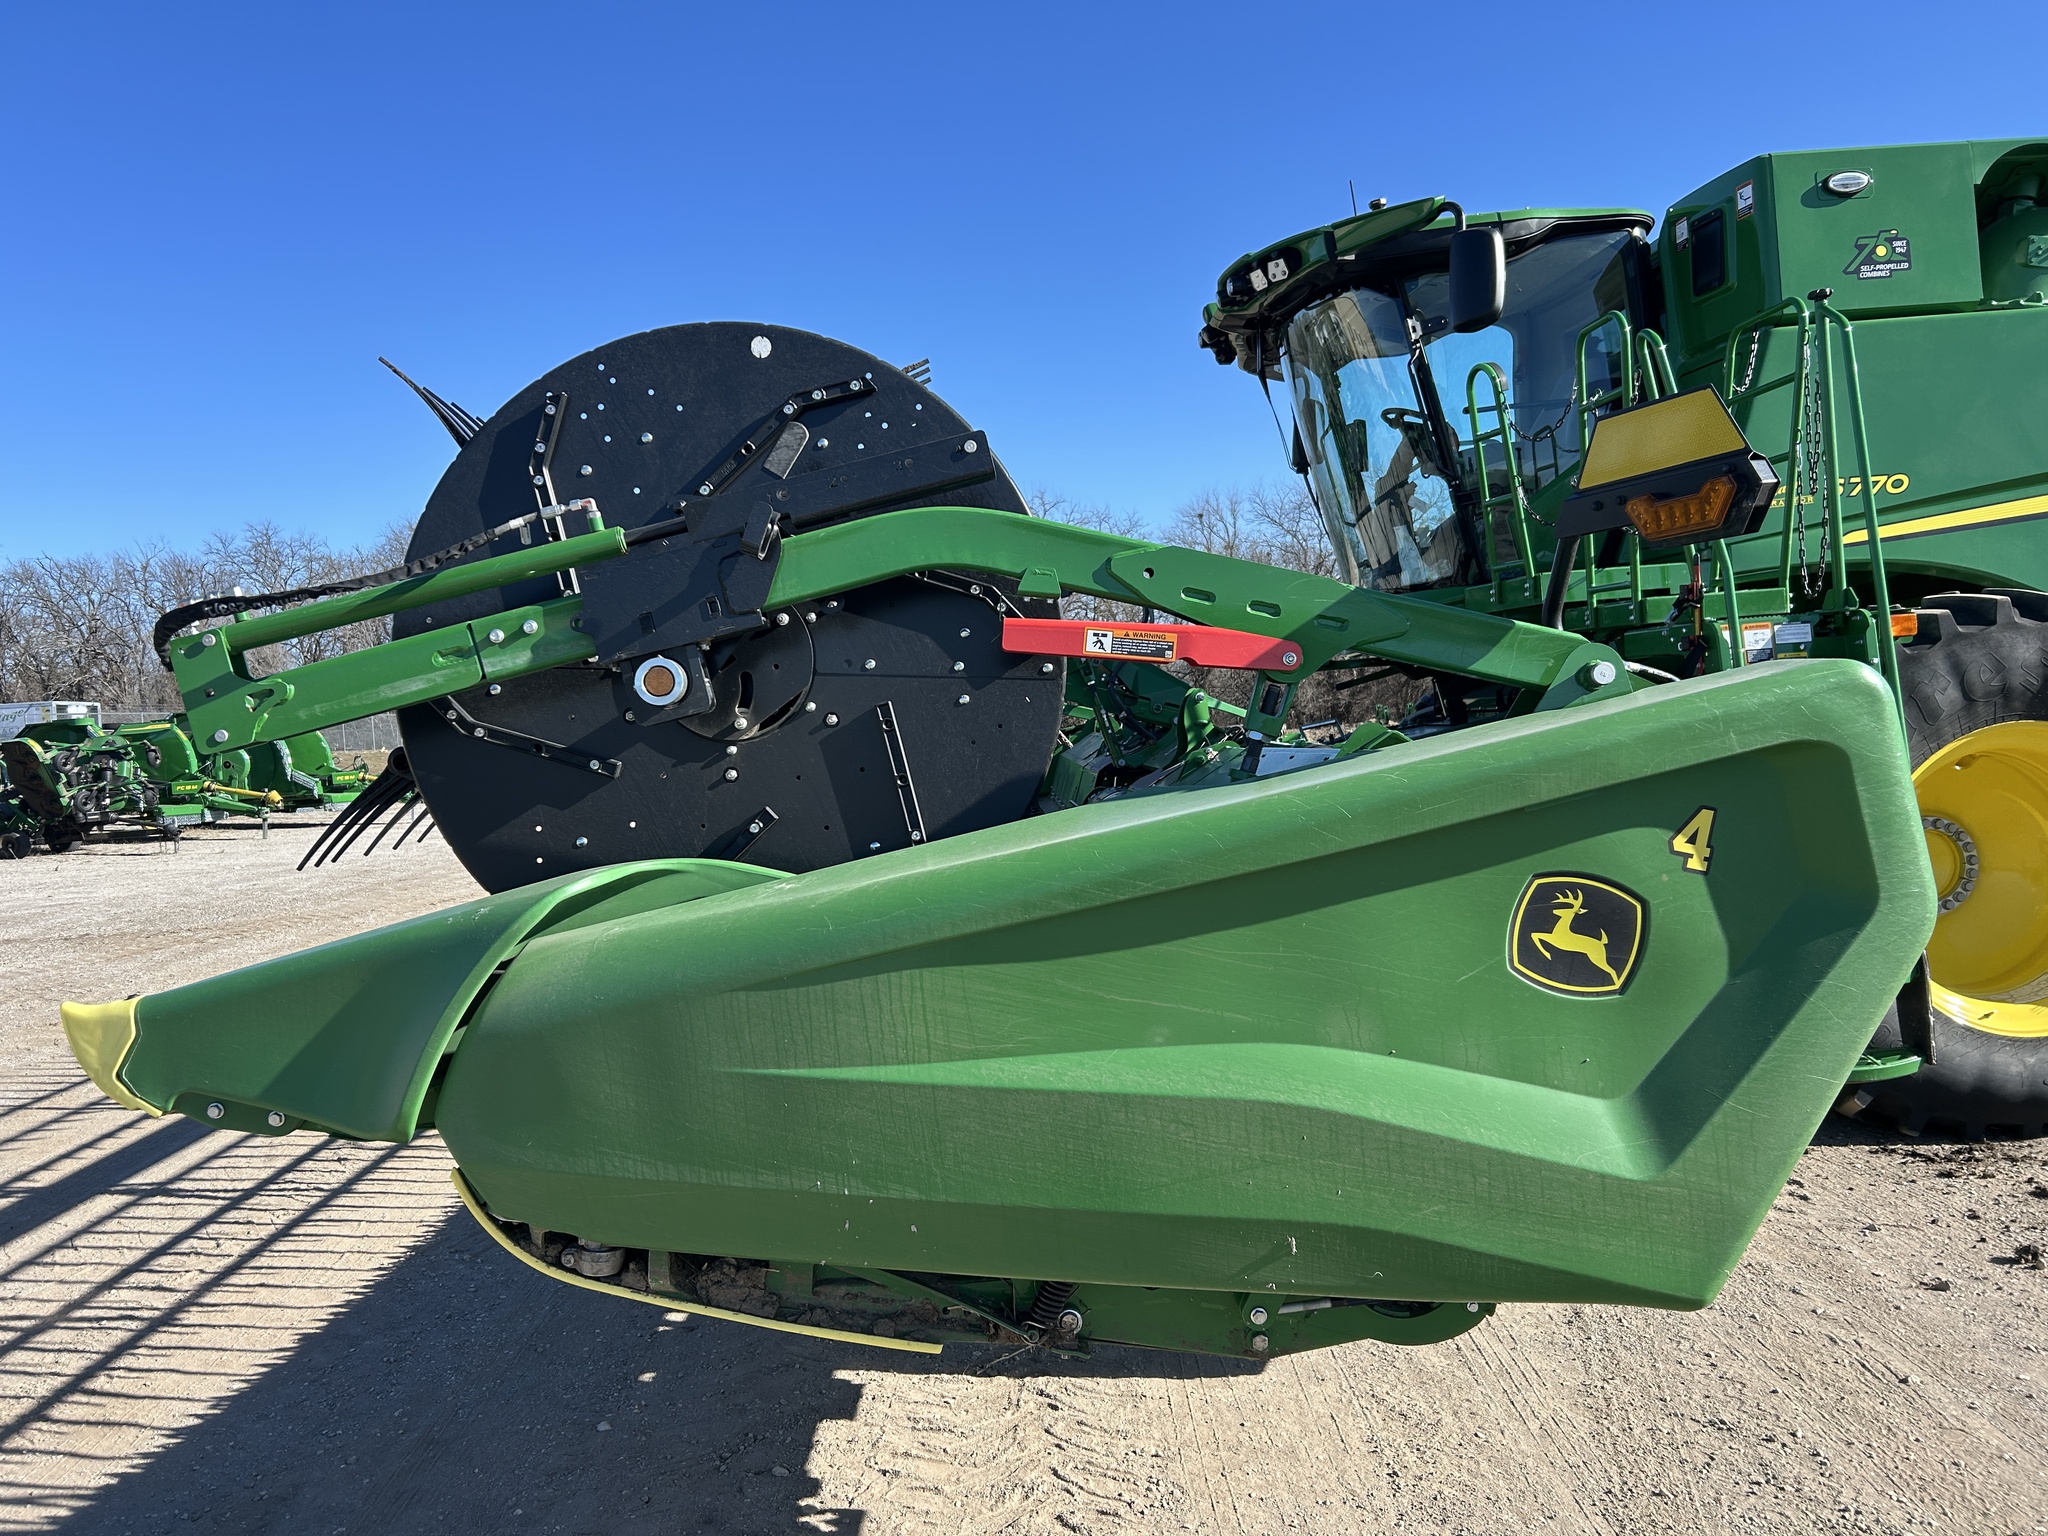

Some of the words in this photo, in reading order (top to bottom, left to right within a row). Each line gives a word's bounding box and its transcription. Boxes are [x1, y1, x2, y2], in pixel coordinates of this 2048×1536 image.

[1860, 262, 1909, 271] SELF-PROPELLED
[1860, 270, 1890, 278] COMBINES
[1132, 632, 1166, 640] WARNING
[1672, 808, 1715, 871] 4
